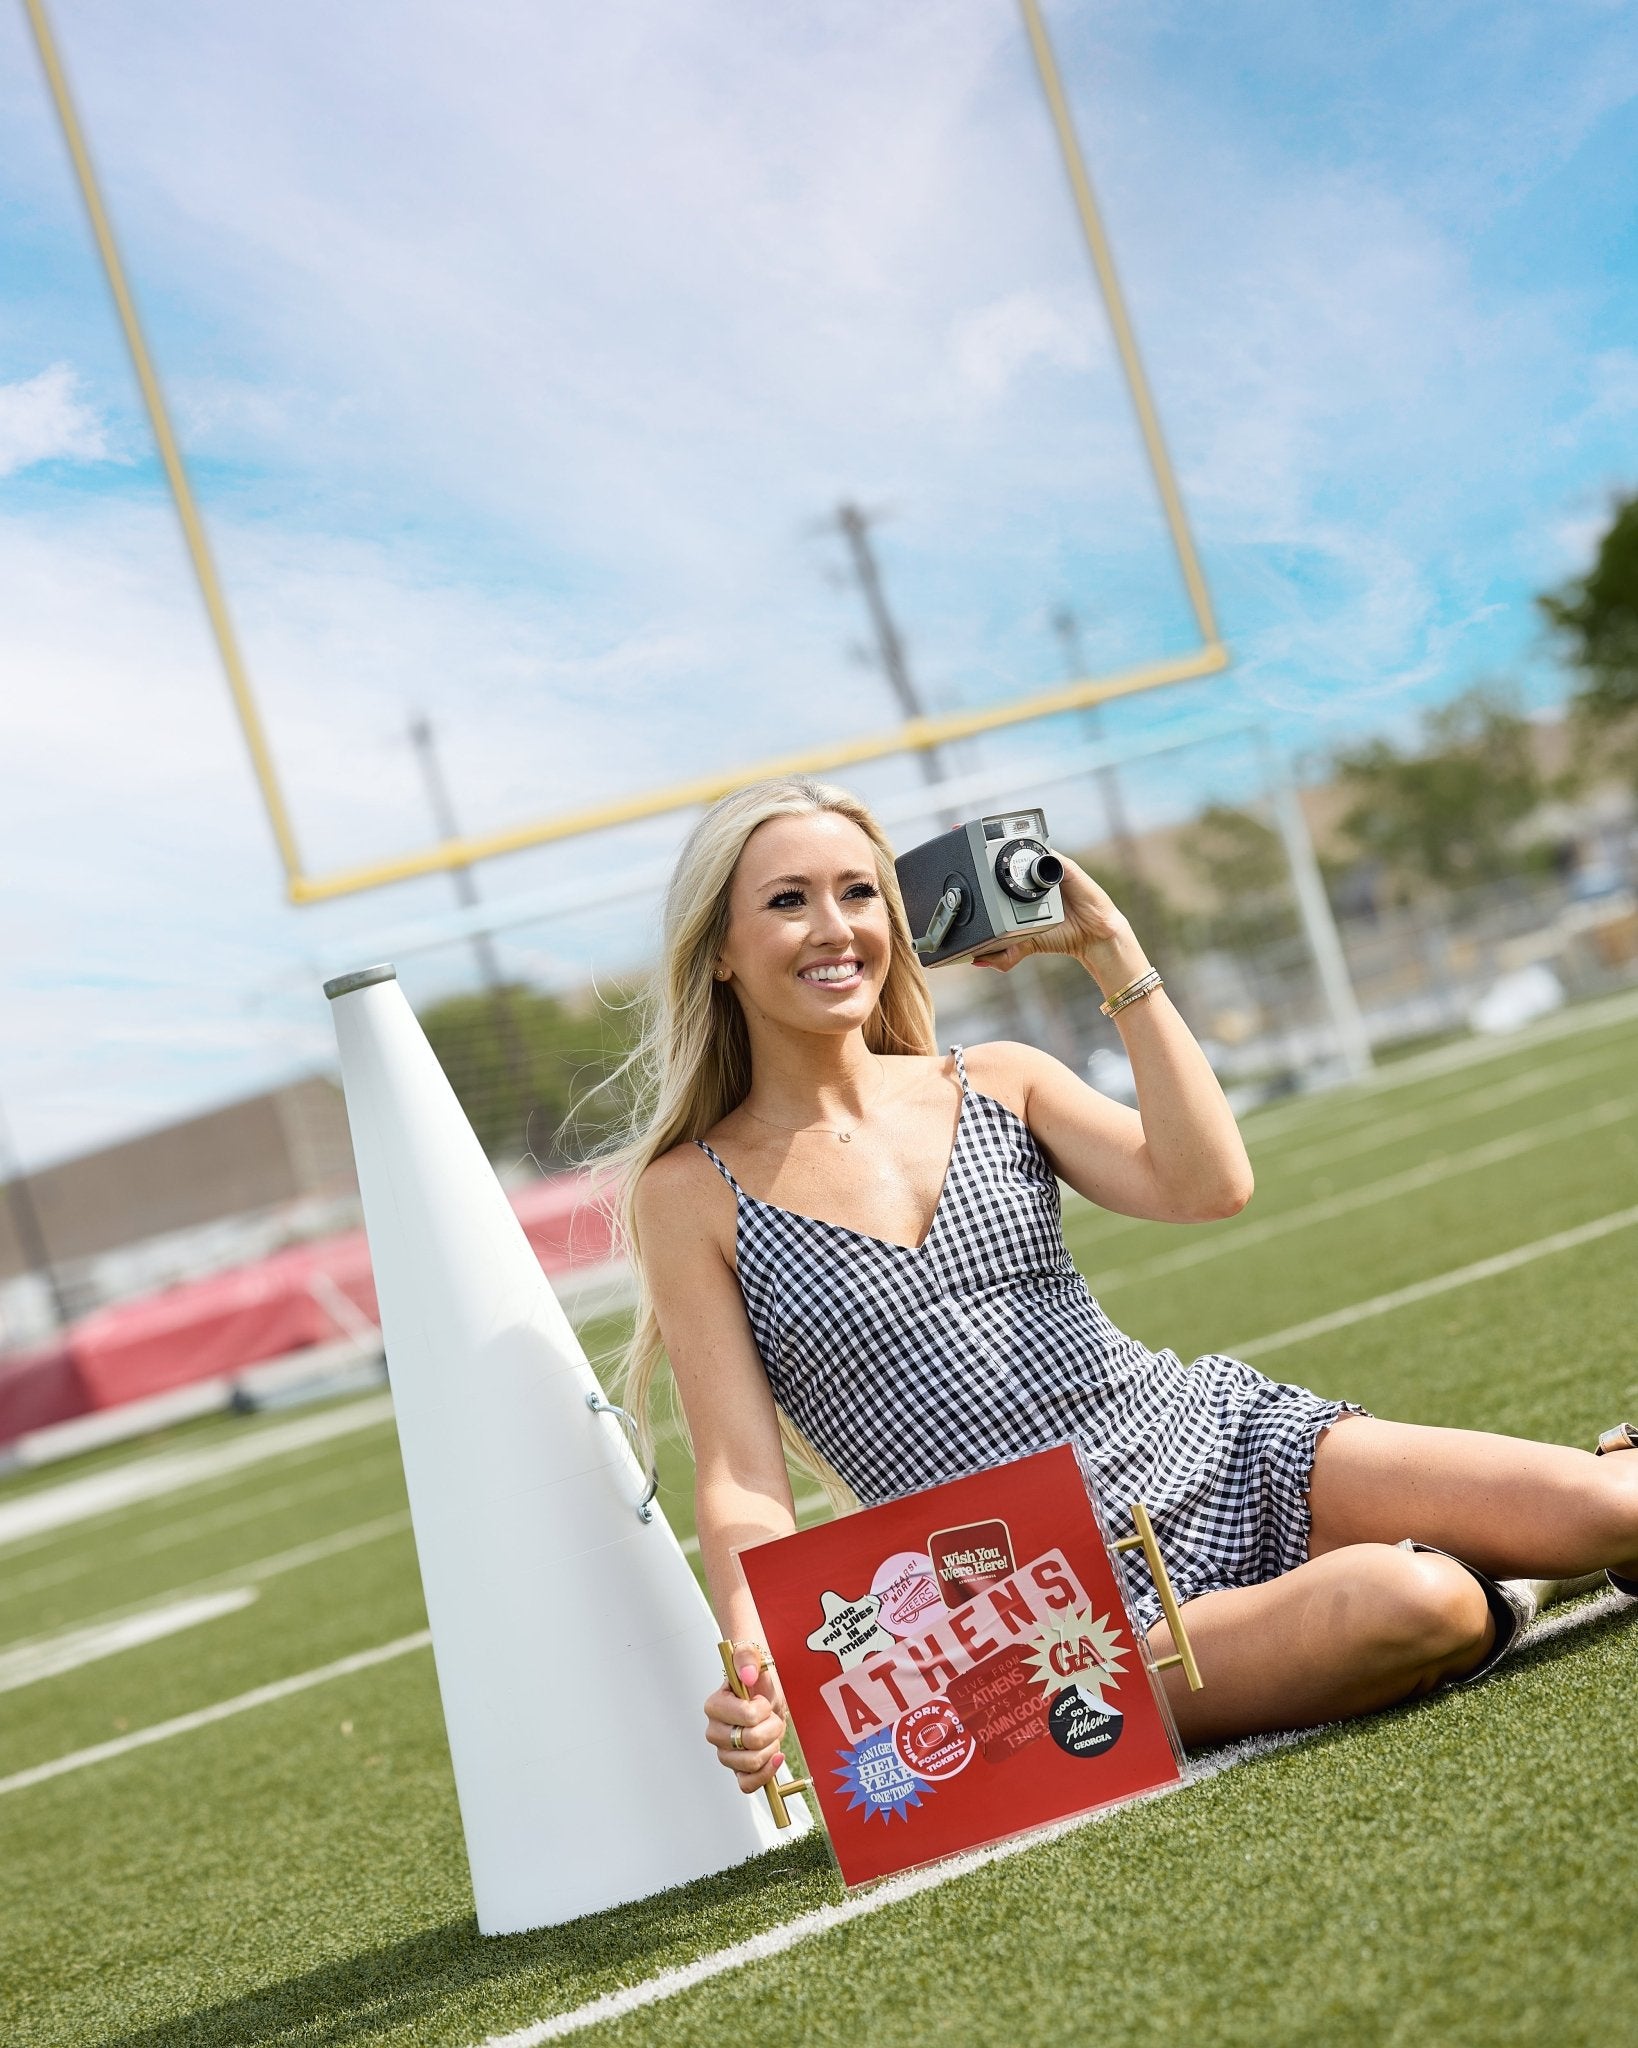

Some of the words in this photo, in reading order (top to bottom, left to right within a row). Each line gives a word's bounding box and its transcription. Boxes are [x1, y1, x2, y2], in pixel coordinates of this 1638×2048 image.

[939, 1565, 973, 1581] Were
[973, 1556, 1008, 1574] Here!
[942, 1551, 976, 1567] Wish
[975, 1548, 1000, 1561] You
[890, 1560, 917, 1592] TEARS!
[891, 1580, 912, 1604] MORE
[899, 1588, 933, 1617] CHEERS
[823, 1628, 842, 1645] FAV
[842, 1606, 873, 1630] LIVES
[829, 1607, 856, 1628] YOUR
[839, 1624, 878, 1656] ATHENS
[847, 1627, 860, 1640] IN
[837, 1560, 1077, 1735] ATHENS
[1049, 1636, 1107, 1677] GA
[957, 1676, 984, 1698] LIVE
[992, 1655, 1020, 1677] FROM
[972, 1667, 1025, 1709] ATHENS
[905, 1706, 940, 1727] WORK
[985, 1698, 1010, 1719] IT'S
[1018, 1690, 1026, 1699] A
[1055, 1696, 1076, 1717] GOOD
[1071, 1708, 1083, 1717] GO
[944, 1709, 964, 1734] FOR
[977, 1712, 1017, 1743] DAMN
[1014, 1692, 1051, 1720] GOOD
[1003, 1717, 1045, 1748] TIME!
[1074, 1733, 1112, 1750] GEORGIA
[859, 1748, 875, 1764] CAN
[902, 1731, 918, 1763] WILL
[918, 1739, 965, 1767] FOOTBALL
[926, 1747, 965, 1772] TICKETS
[857, 1756, 901, 1780] HEL
[870, 1790, 893, 1803] ONE
[889, 1781, 916, 1801] TIME
